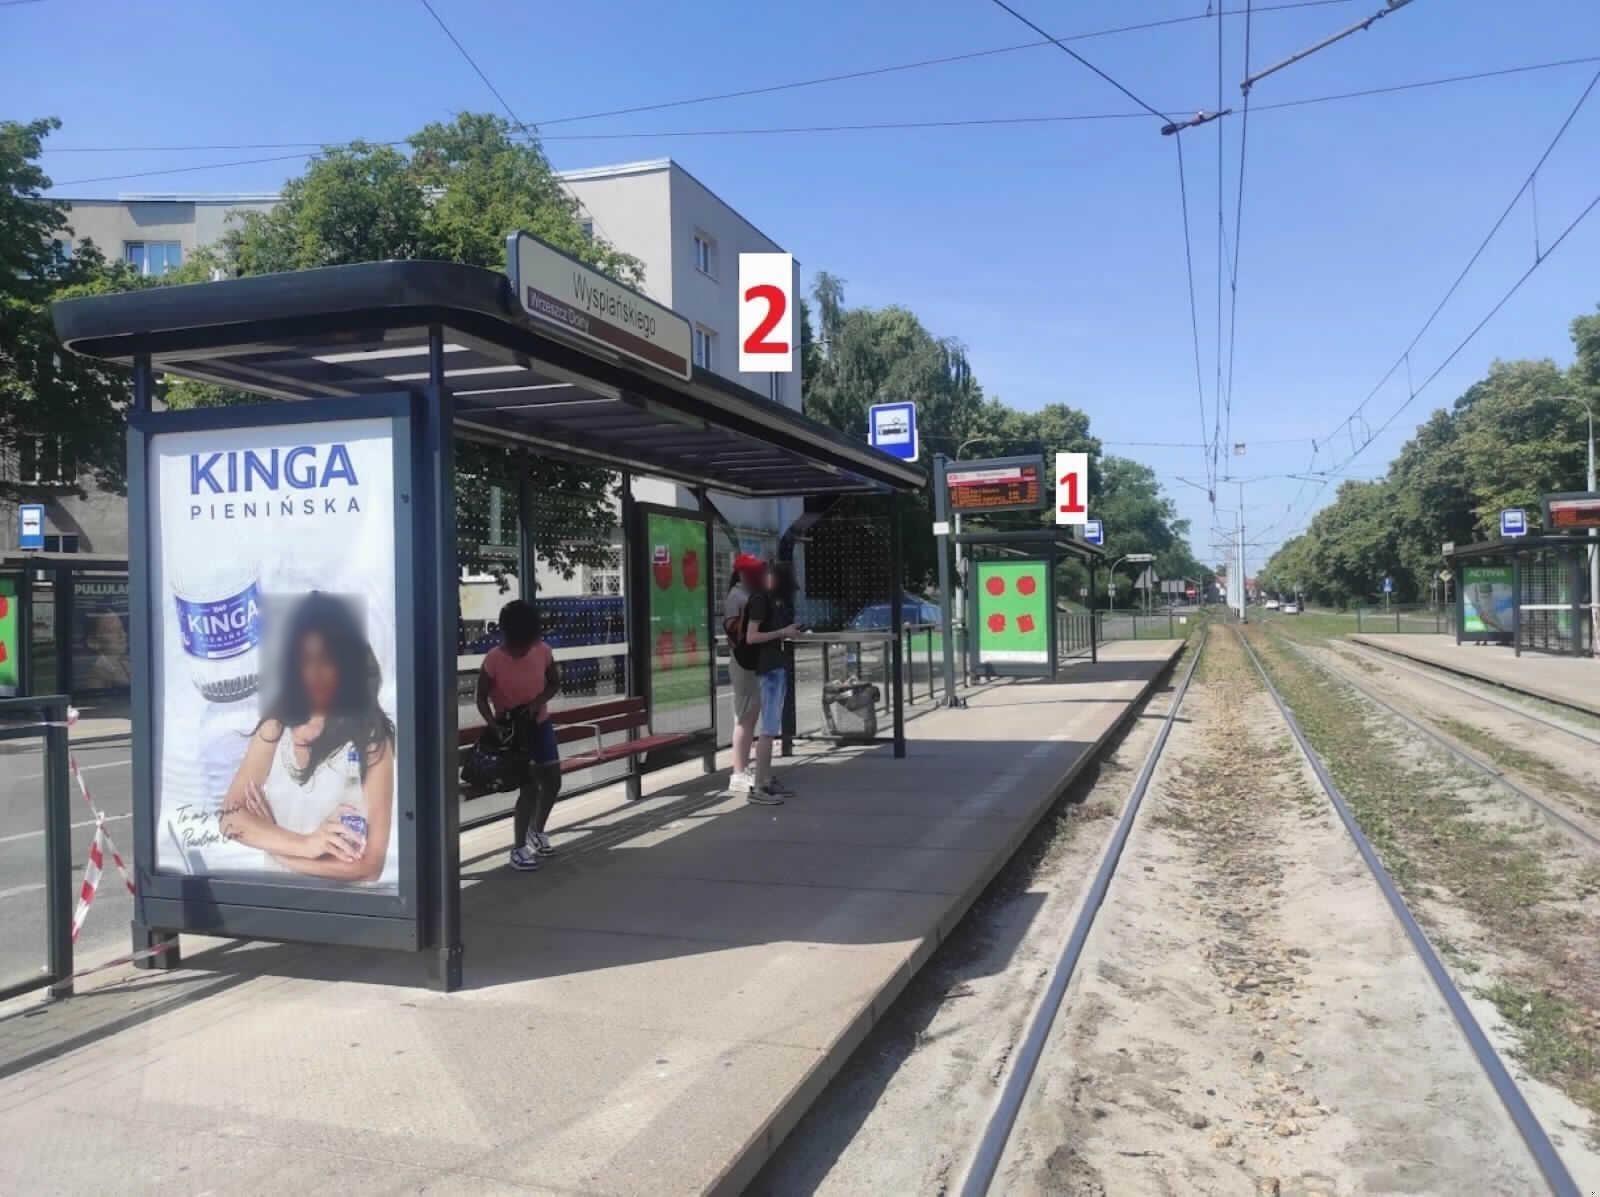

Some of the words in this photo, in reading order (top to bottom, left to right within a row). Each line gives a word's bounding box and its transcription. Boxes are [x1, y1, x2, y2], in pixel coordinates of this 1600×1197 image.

[573, 271, 656, 339] Wyspiańskiego
[190, 444, 359, 495] KINGA
[190, 496, 361, 521] PIENIŃSKA
[74, 583, 129, 595] PULLULA
[187, 600, 257, 635] KINGA
